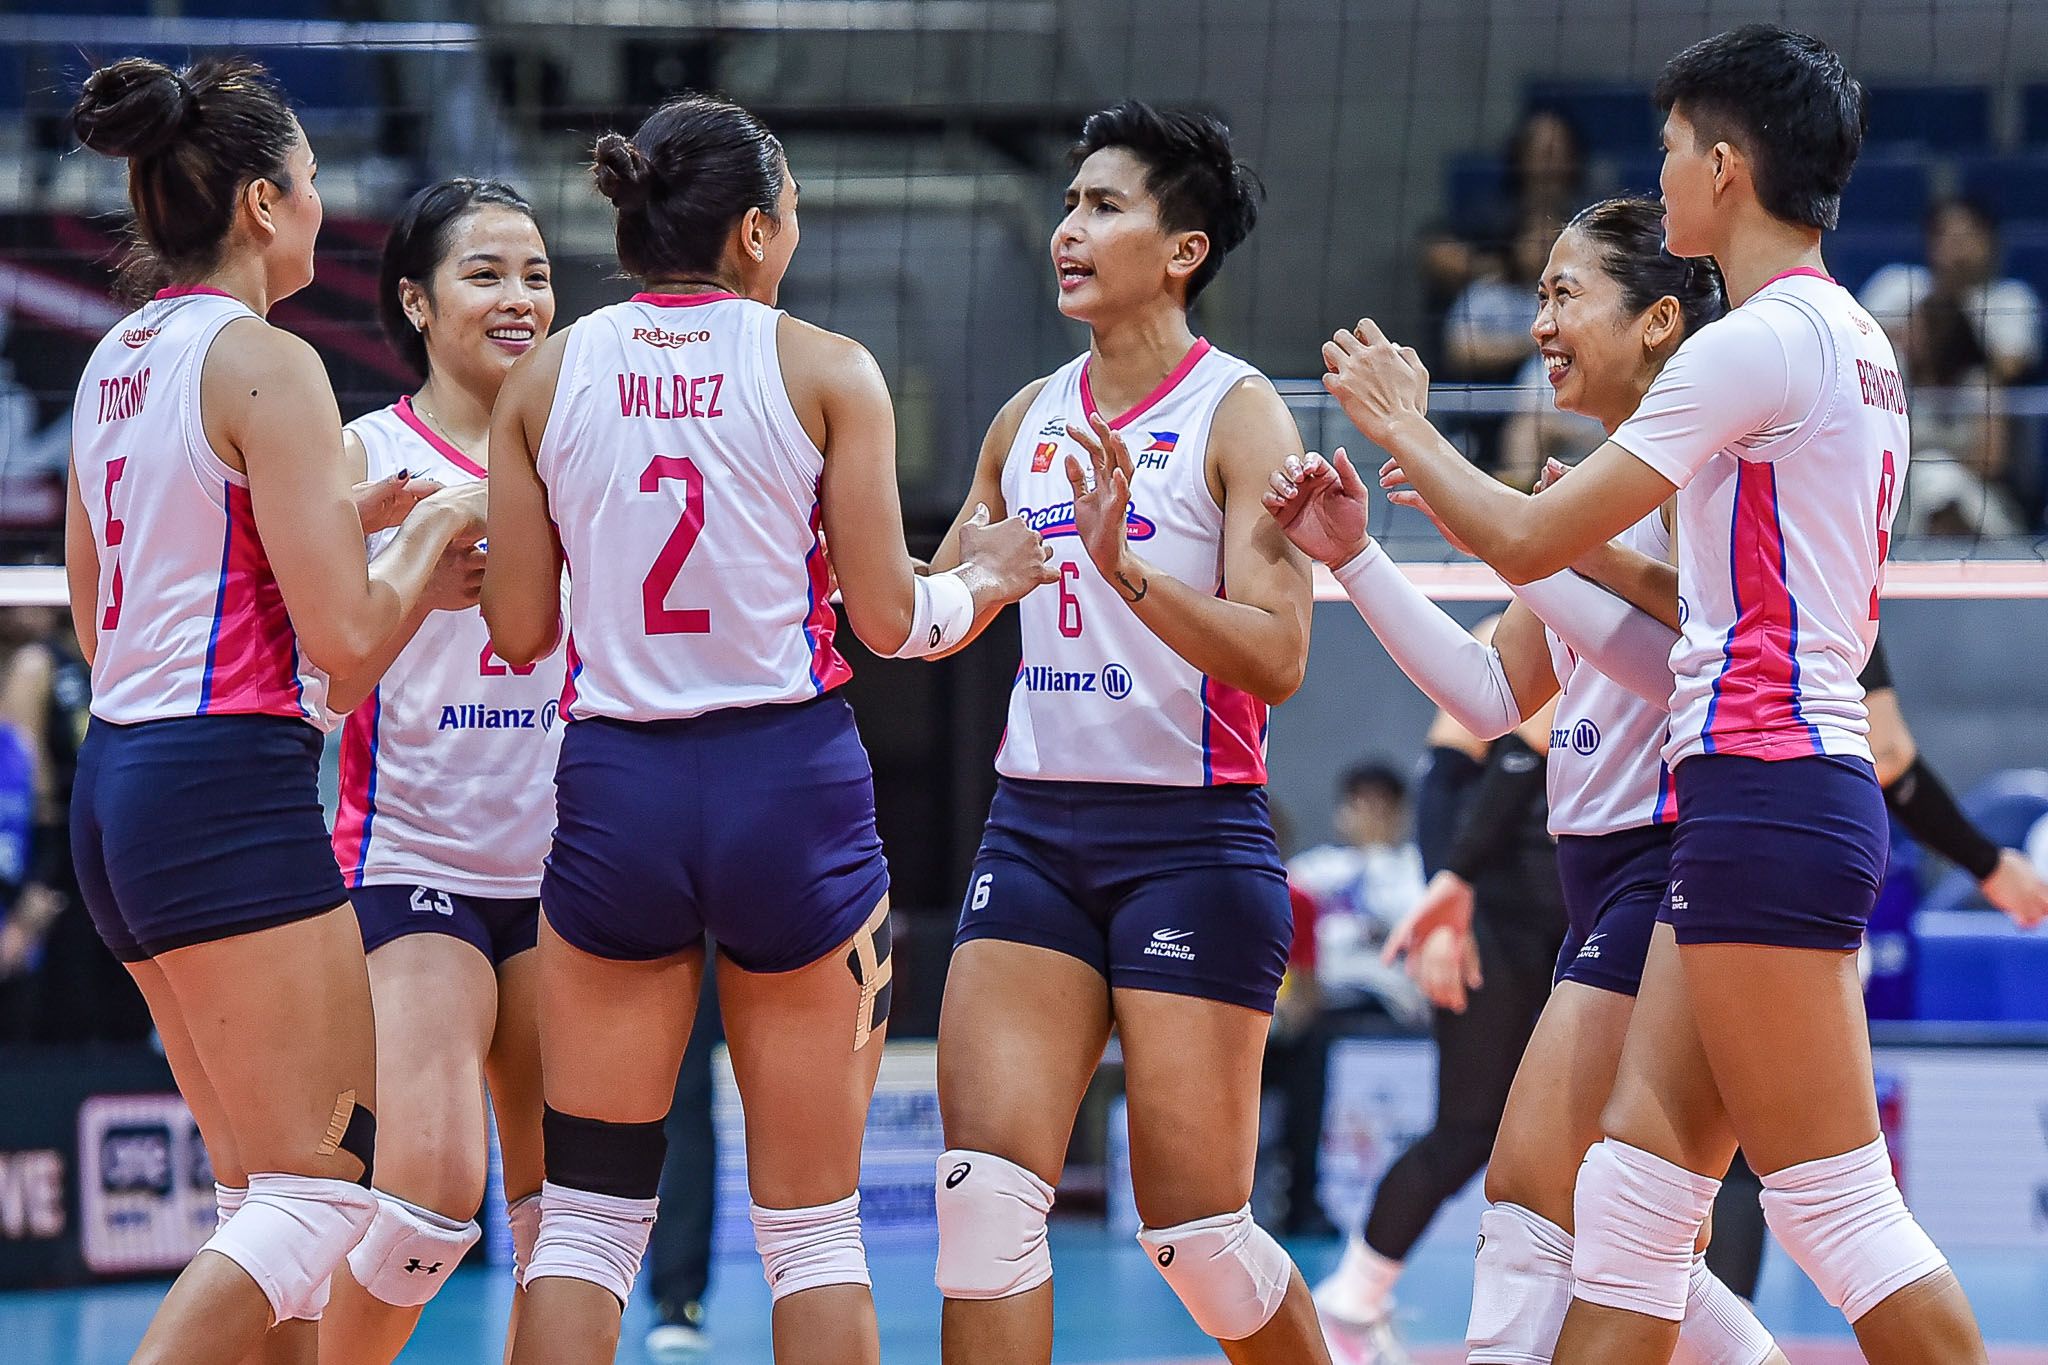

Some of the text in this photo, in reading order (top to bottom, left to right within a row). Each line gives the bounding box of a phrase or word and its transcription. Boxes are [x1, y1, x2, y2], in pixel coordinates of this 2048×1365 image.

[632, 327, 710, 349] Rebisco
[618, 372, 724, 419] VALDEZ
[1137, 453, 1169, 469] PHI
[101, 455, 128, 631] 5
[639, 454, 711, 636] 2
[1058, 562, 1083, 638] 6
[437, 703, 535, 731] Allianz
[410, 885, 454, 916] 23
[971, 873, 994, 911] 6
[1143, 947, 1196, 960] BALANCE
[1150, 940, 1191, 952] WORLD
